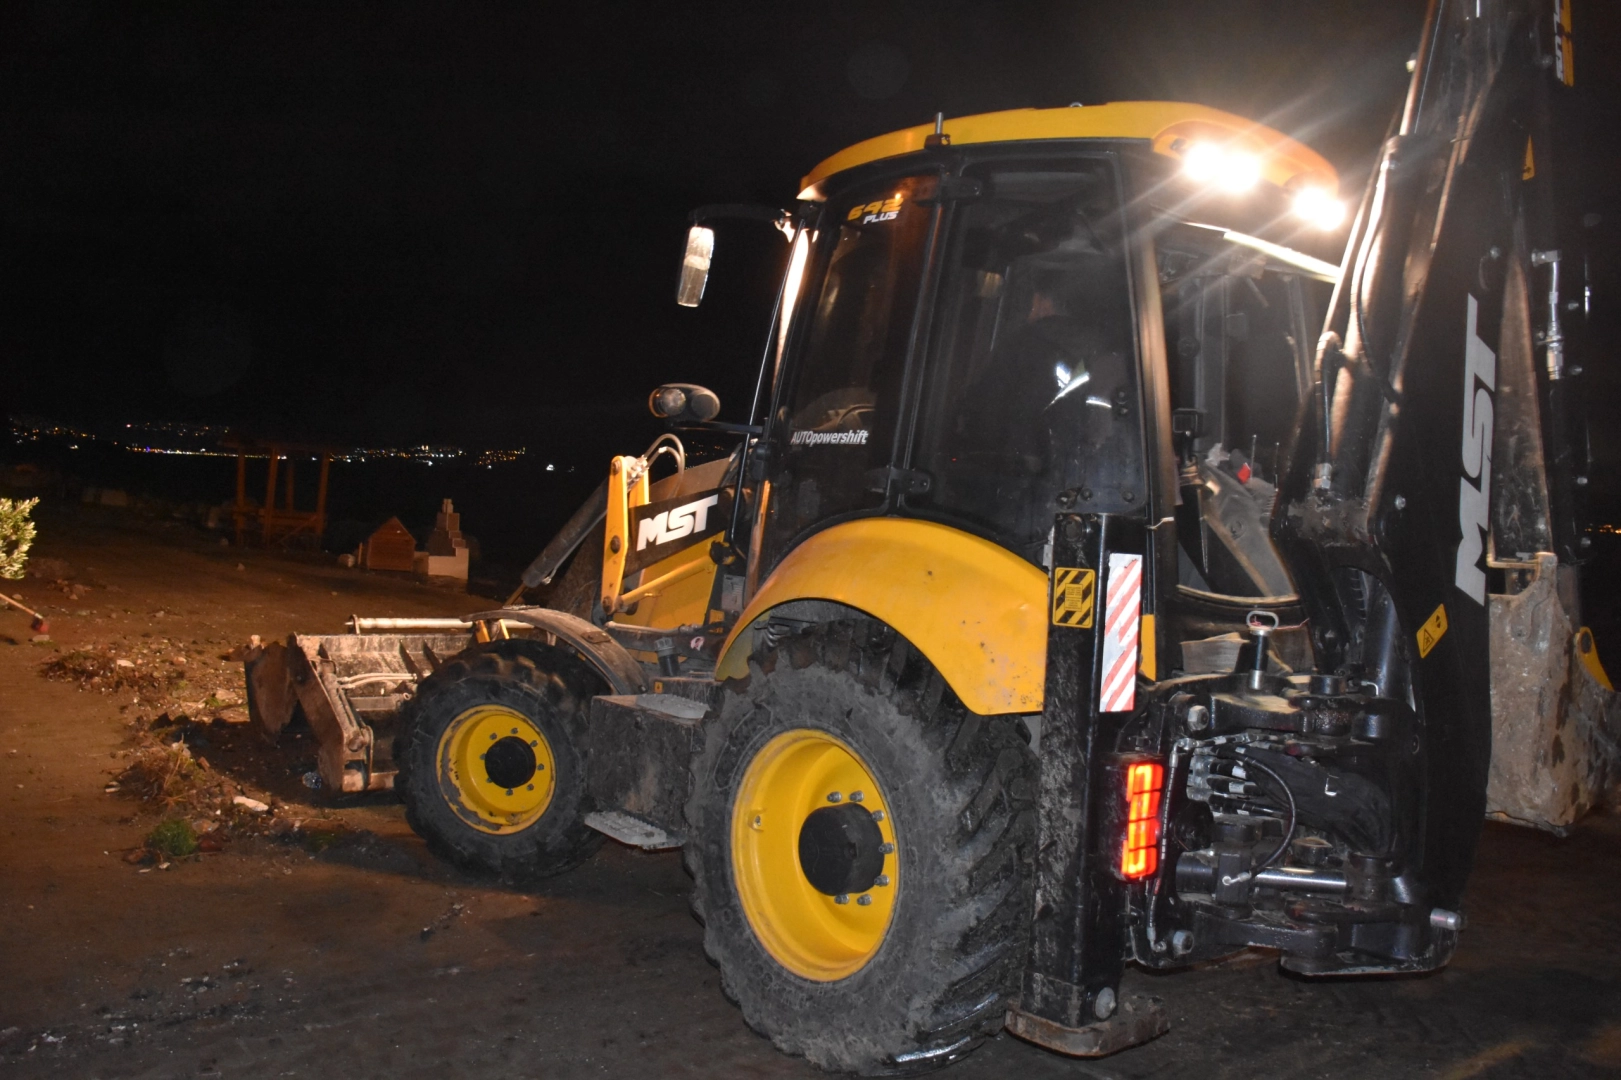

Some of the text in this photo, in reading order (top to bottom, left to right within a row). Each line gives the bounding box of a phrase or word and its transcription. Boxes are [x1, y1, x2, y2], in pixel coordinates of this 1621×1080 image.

[847, 198, 904, 221] 642
[863, 211, 899, 224] PLUS
[790, 429, 868, 447] AUTOpowershift
[1455, 292, 1496, 606] MST
[636, 493, 718, 552] MST
